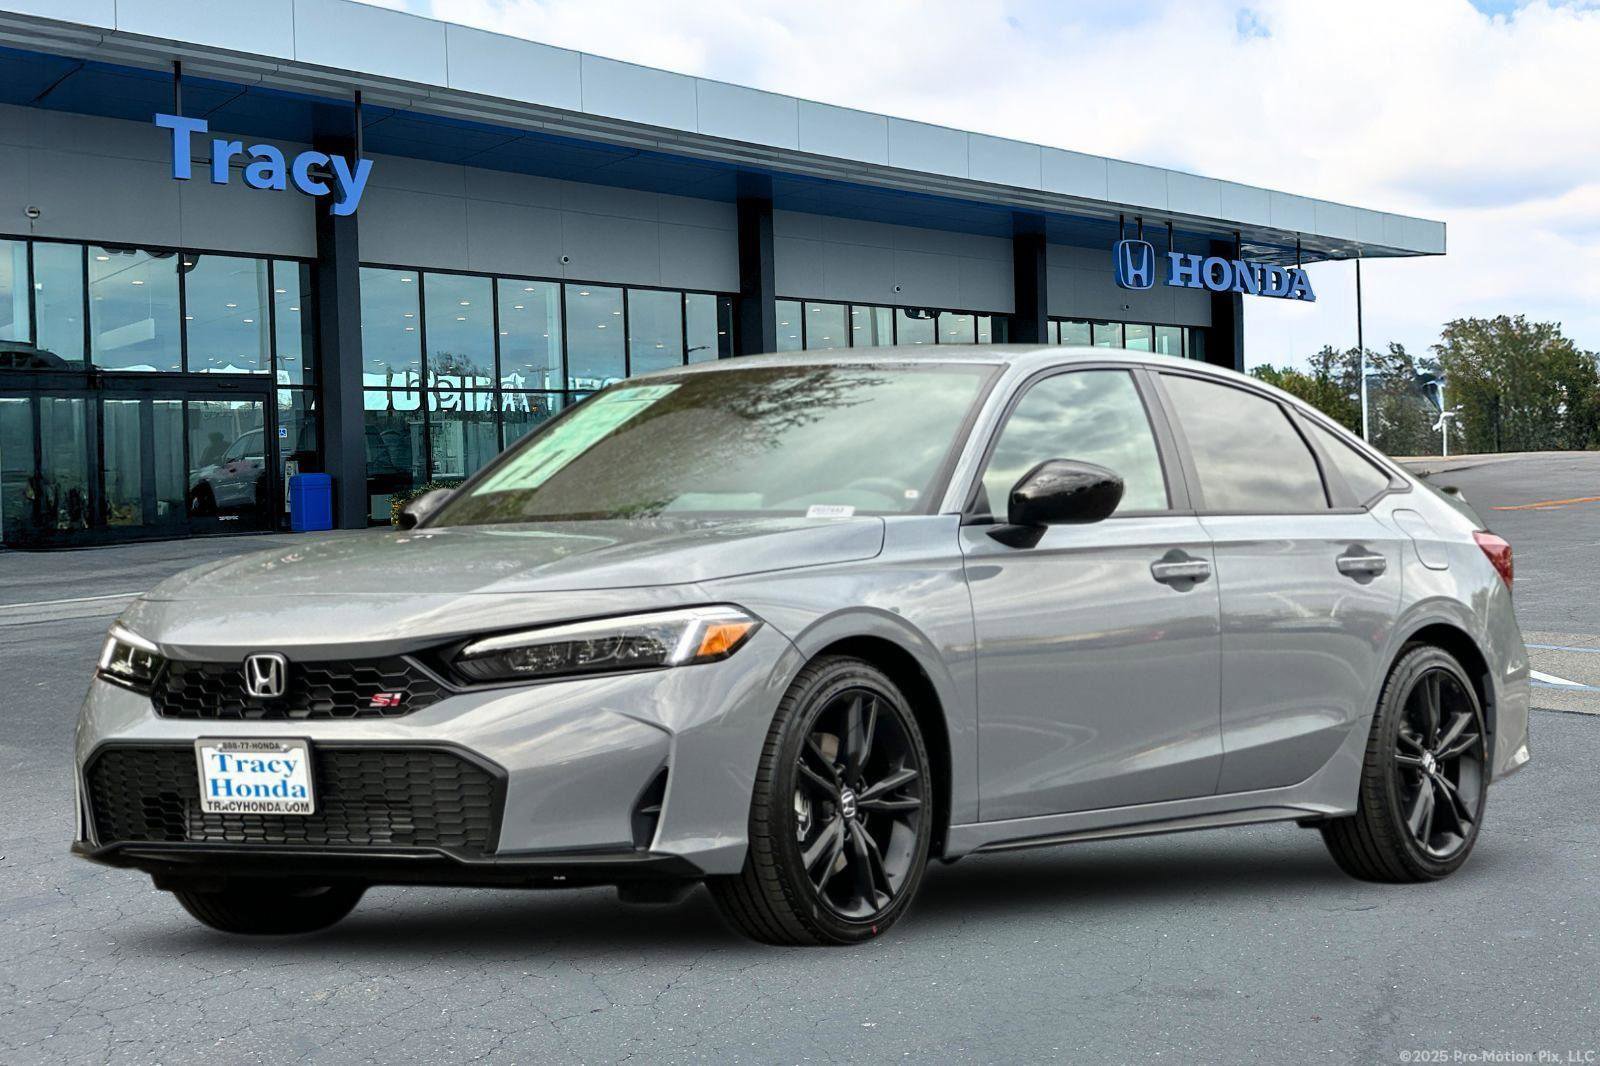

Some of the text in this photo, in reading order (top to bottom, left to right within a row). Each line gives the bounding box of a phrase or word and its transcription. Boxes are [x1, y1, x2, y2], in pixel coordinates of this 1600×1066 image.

[155, 113, 374, 216] Tracy
[1167, 251, 1316, 301] HONDA
[211, 754, 297, 778] Tracy
[210, 778, 307, 798] Honda
[207, 801, 310, 813] TRACYHONDA.COM
